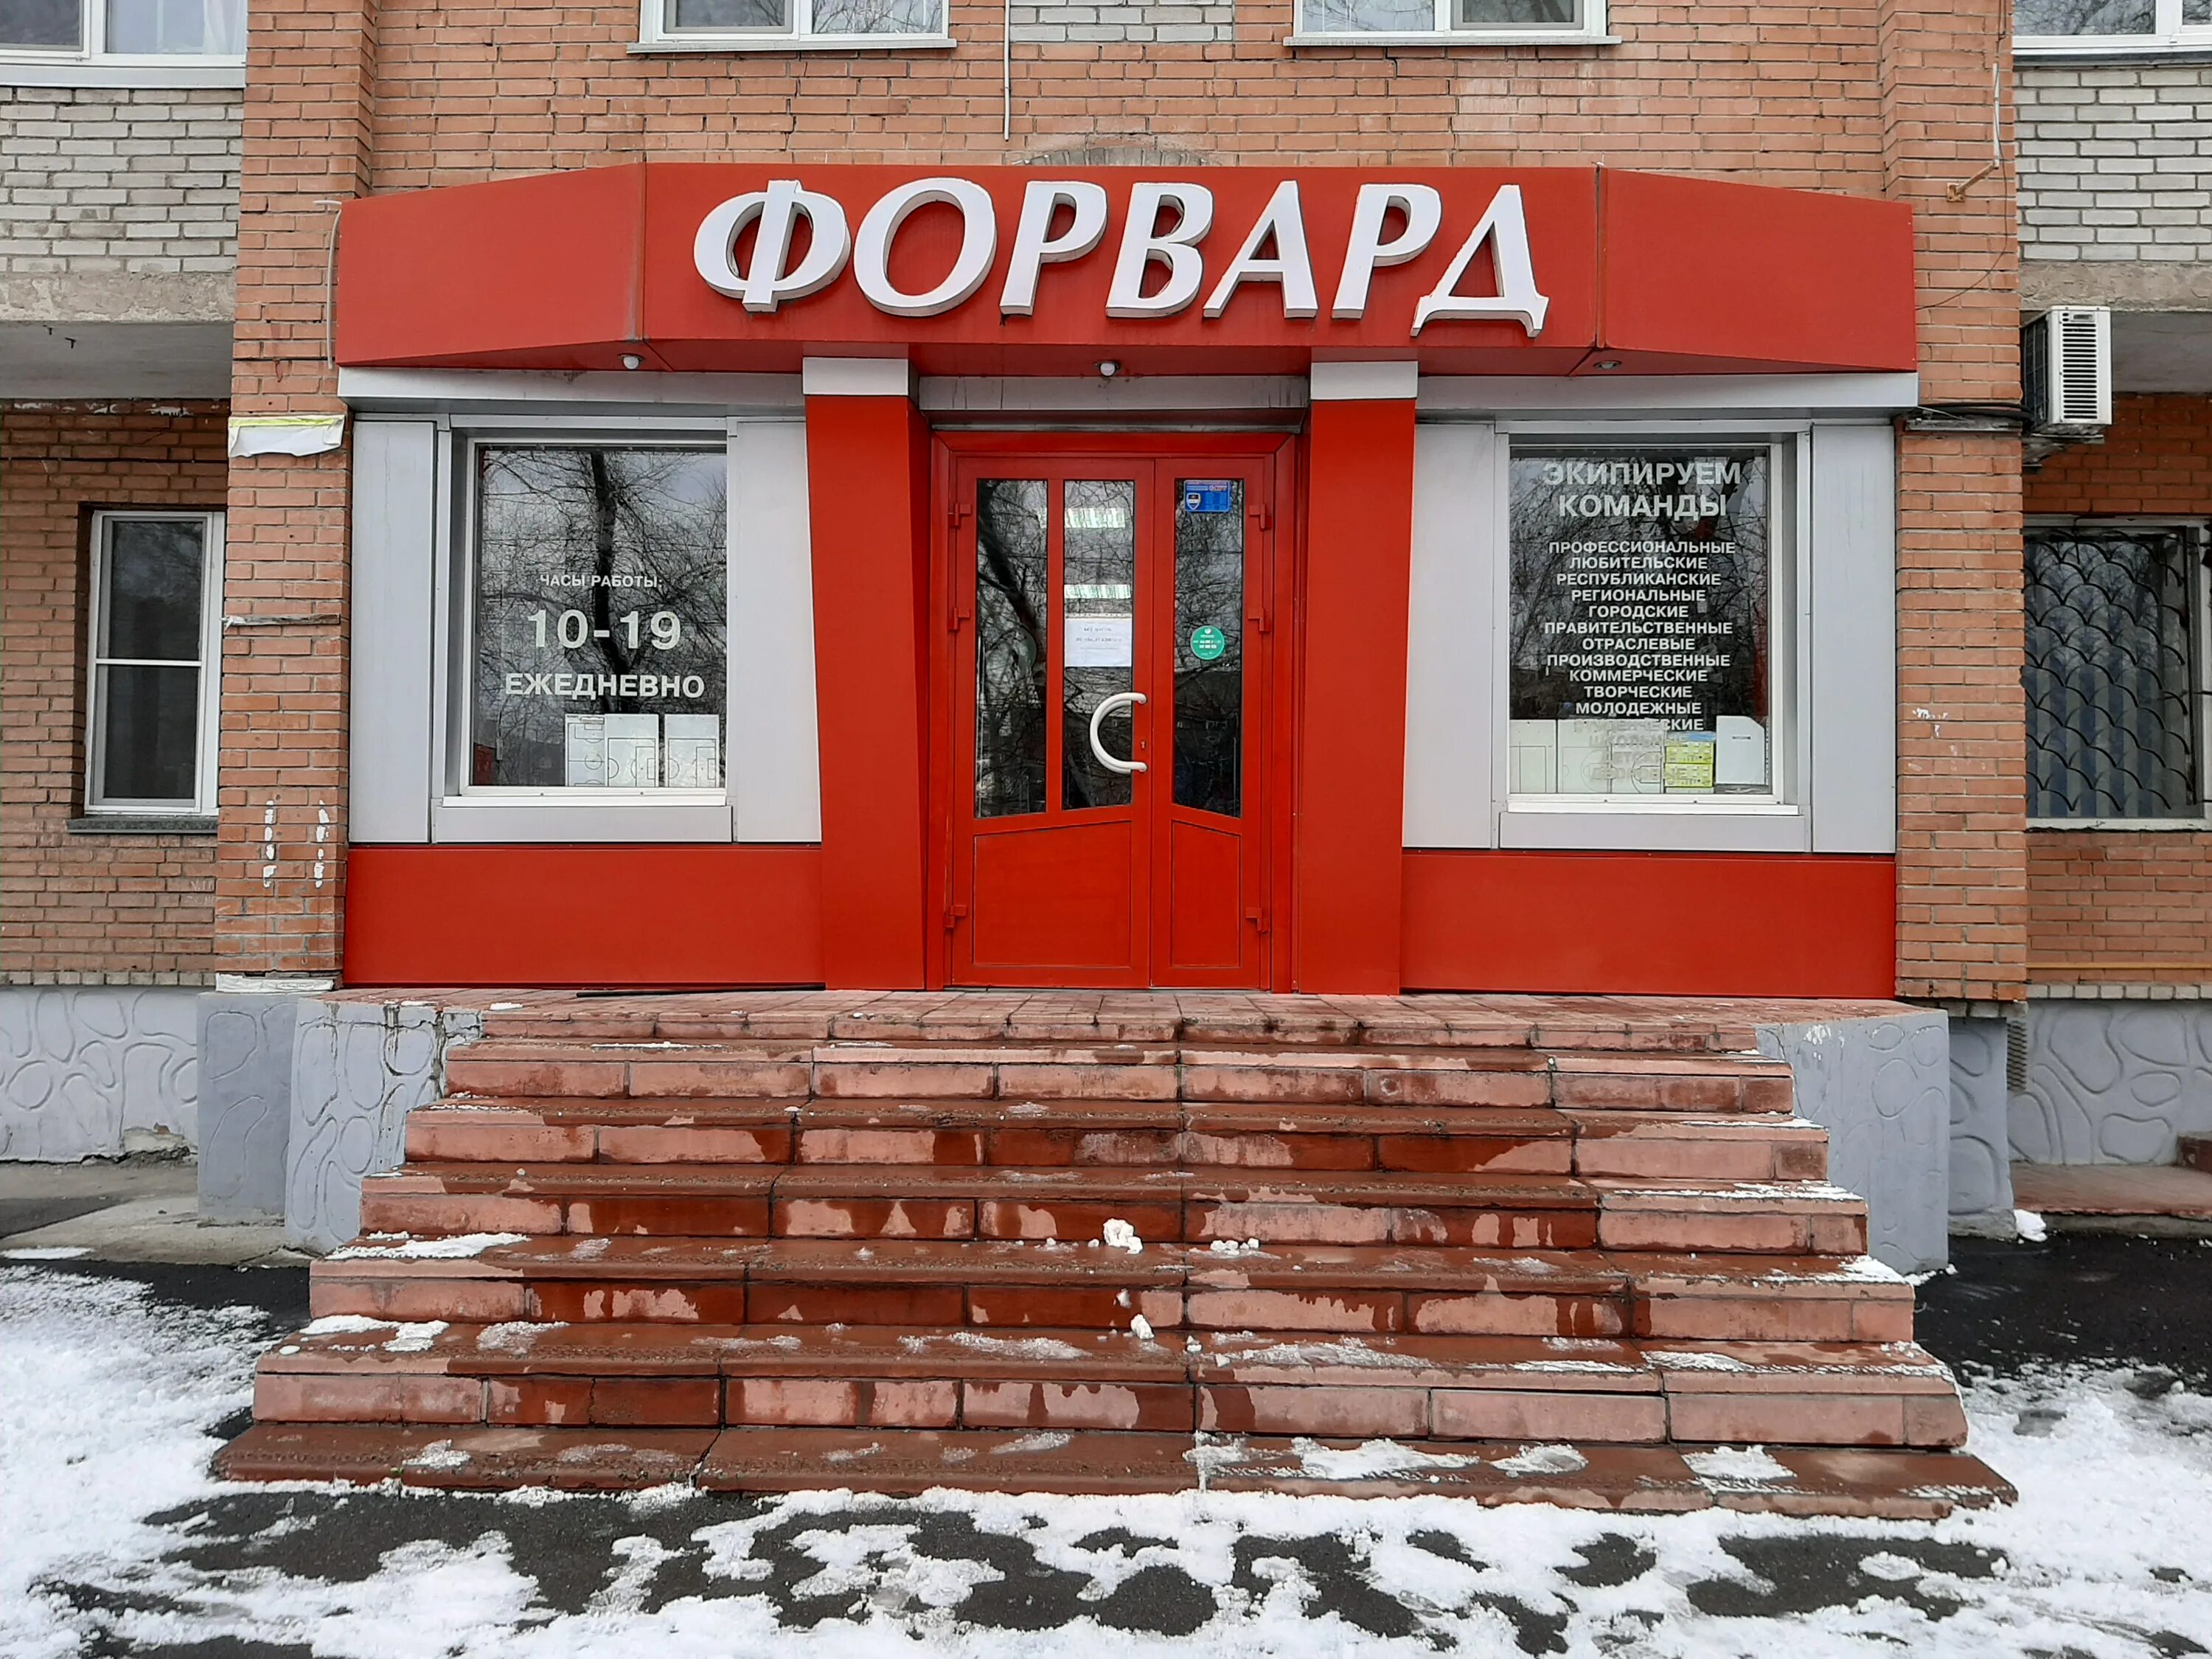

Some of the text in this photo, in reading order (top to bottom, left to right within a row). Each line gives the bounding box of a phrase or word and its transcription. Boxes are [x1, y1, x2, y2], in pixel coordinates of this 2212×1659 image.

[693, 177, 1550, 338] ФОРВАРД
[1543, 462, 1741, 486] ЭКИПИРУЕМ
[1559, 494, 1727, 521] КОМАНДЫ
[1548, 540, 1736, 554] ПРОФЕССИОНАЛЬНЫЕ
[1569, 557, 1708, 569] ЛЮБИТЕЛЬСКИЕ
[540, 574, 585, 587] ЧАСЫ
[1557, 573, 1722, 585] РЕСПУБЛИКАНСКИЕ
[1571, 589, 1706, 602] РЕГИОНАЛЬНЫЕ
[1588, 605, 1688, 620] ГОРОДСКИЕ
[527, 608, 681, 650] 10-19
[1545, 622, 1733, 634] ПРАВИТЕЛЬСТВЕННЫЕ
[1582, 638, 1695, 650] ОТРАСЛЕВЫЕ
[1547, 654, 1731, 668] ПРОИЗВОДСТВЕННЫЕ
[1569, 670, 1708, 682] КОММЕРЧЕСКИЕ
[505, 672, 705, 700] ЕЖЕДНЕВНО
[1584, 686, 1693, 698] ТВОРЧЕСКИЕ
[1576, 702, 1702, 716] МОЛОДЕЖНЫЕ
